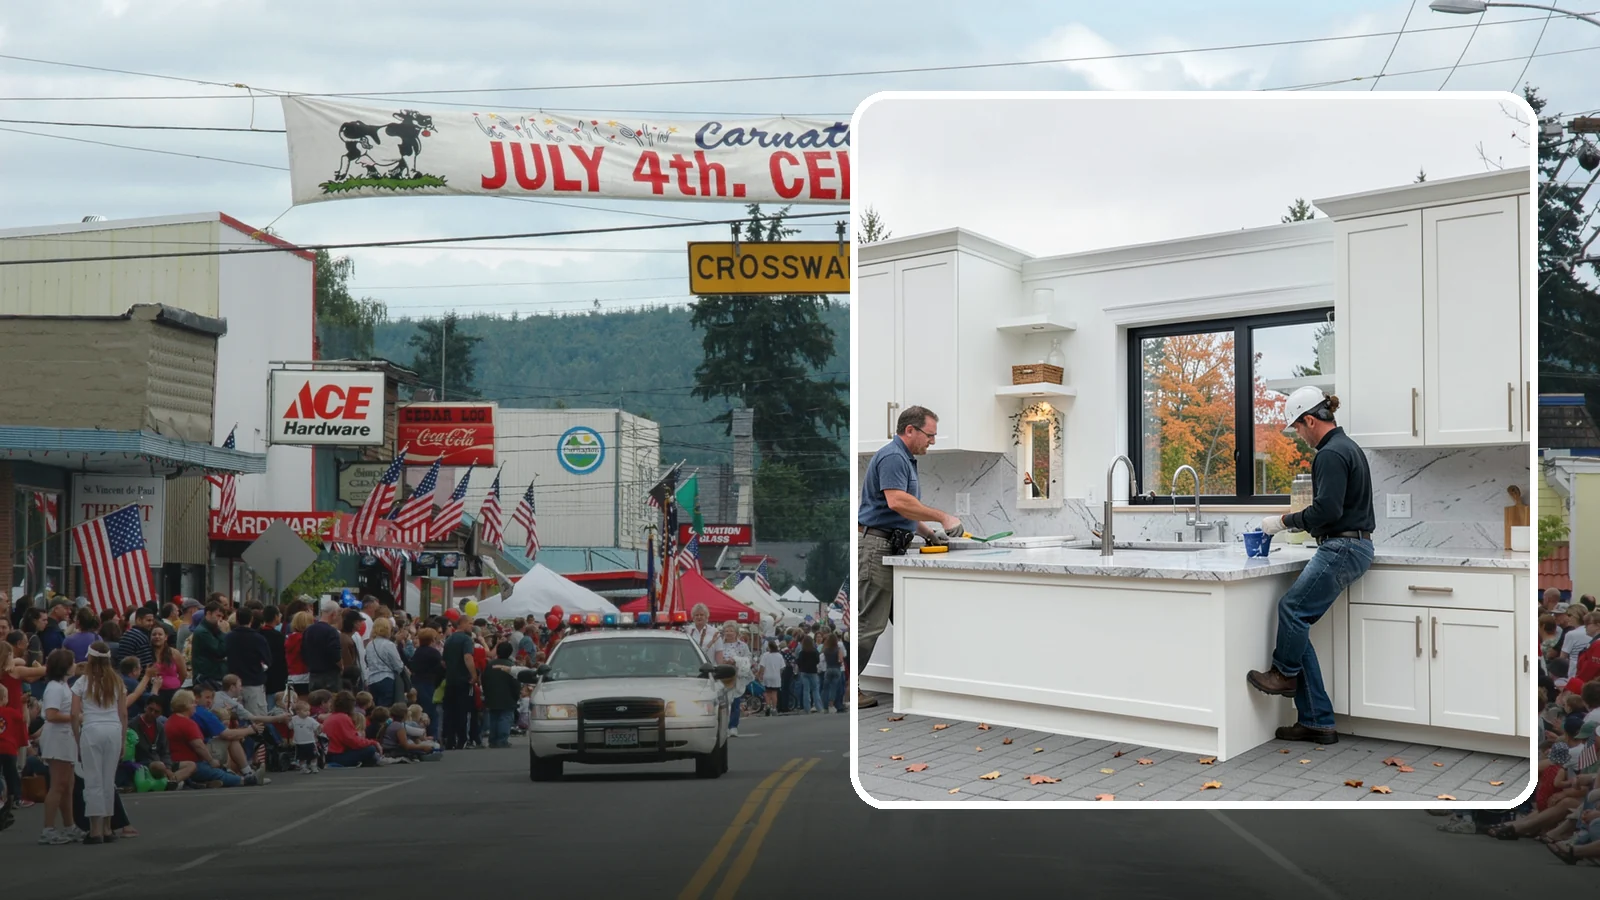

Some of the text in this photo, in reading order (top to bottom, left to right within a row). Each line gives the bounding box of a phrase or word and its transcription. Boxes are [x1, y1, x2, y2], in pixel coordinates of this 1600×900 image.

[695, 121, 850, 150] Carnat
[481, 141, 605, 192] JULY
[632, 150, 746, 198] 4th.
[697, 254, 850, 280] CROSSWA
[283, 380, 373, 420] ACE
[406, 409, 485, 422] CEDAR LOG
[283, 421, 371, 437] Hardware
[416, 428, 477, 447] Coca-Cola
[83, 485, 155, 495] St. Vincent de Paul
[688, 527, 741, 535] CRNATION
[699, 535, 730, 543] GLASS
